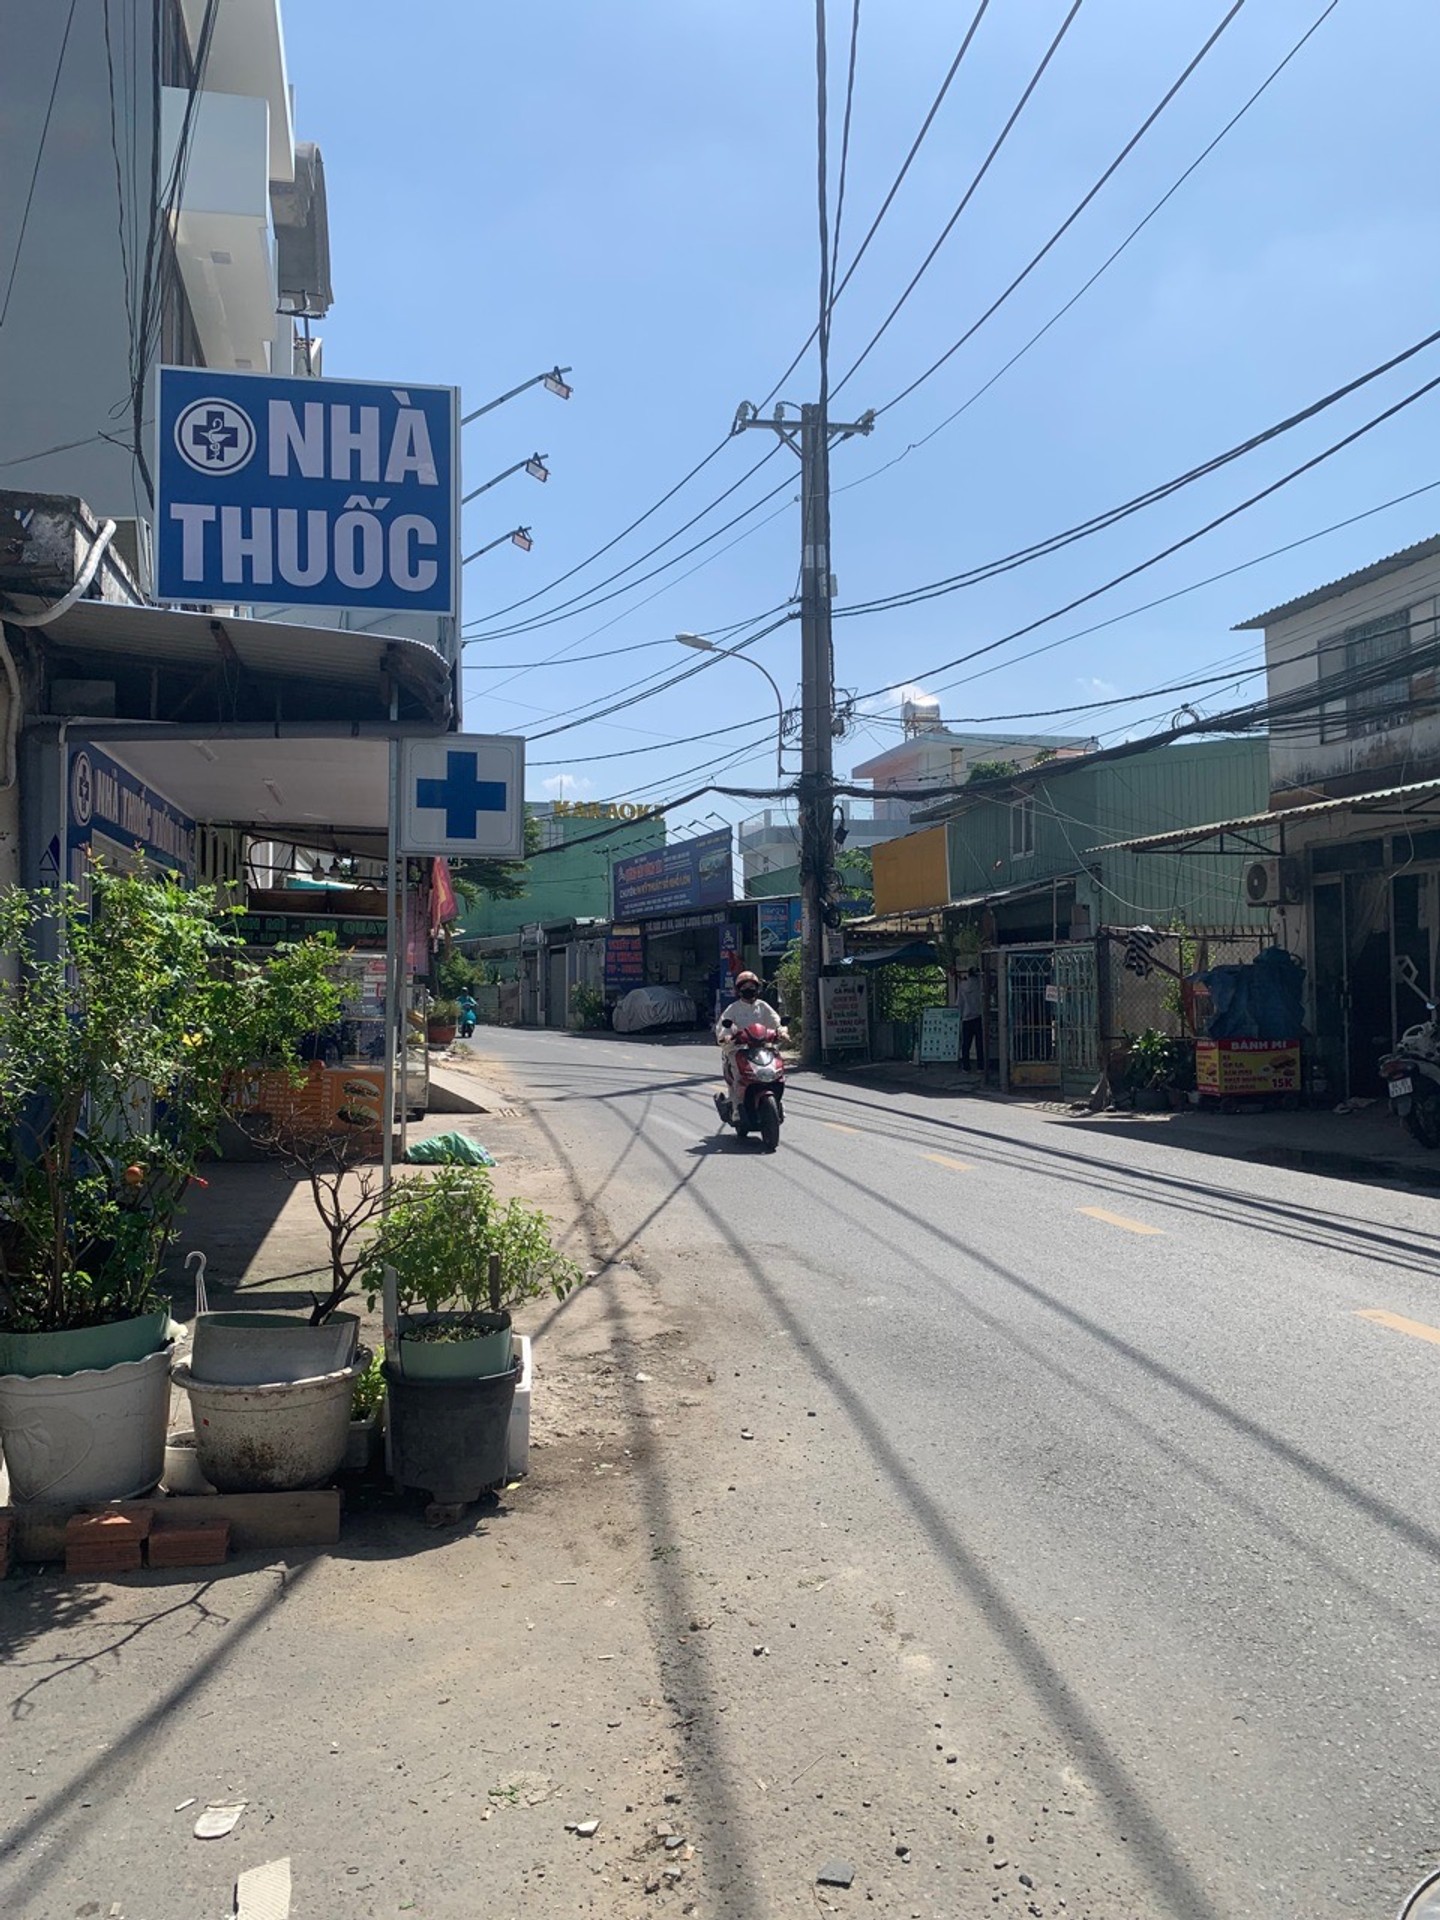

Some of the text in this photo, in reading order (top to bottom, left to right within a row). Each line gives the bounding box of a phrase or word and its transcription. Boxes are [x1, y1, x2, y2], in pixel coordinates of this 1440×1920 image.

[268, 390, 439, 485] NHÀ
[170, 495, 438, 592] THUỐC
[94, 768, 119, 824] NHÀ
[120, 786, 151, 841] THUỐC
[343, 921, 387, 934] QUAY
[1271, 1078, 1293, 1088] 15K
